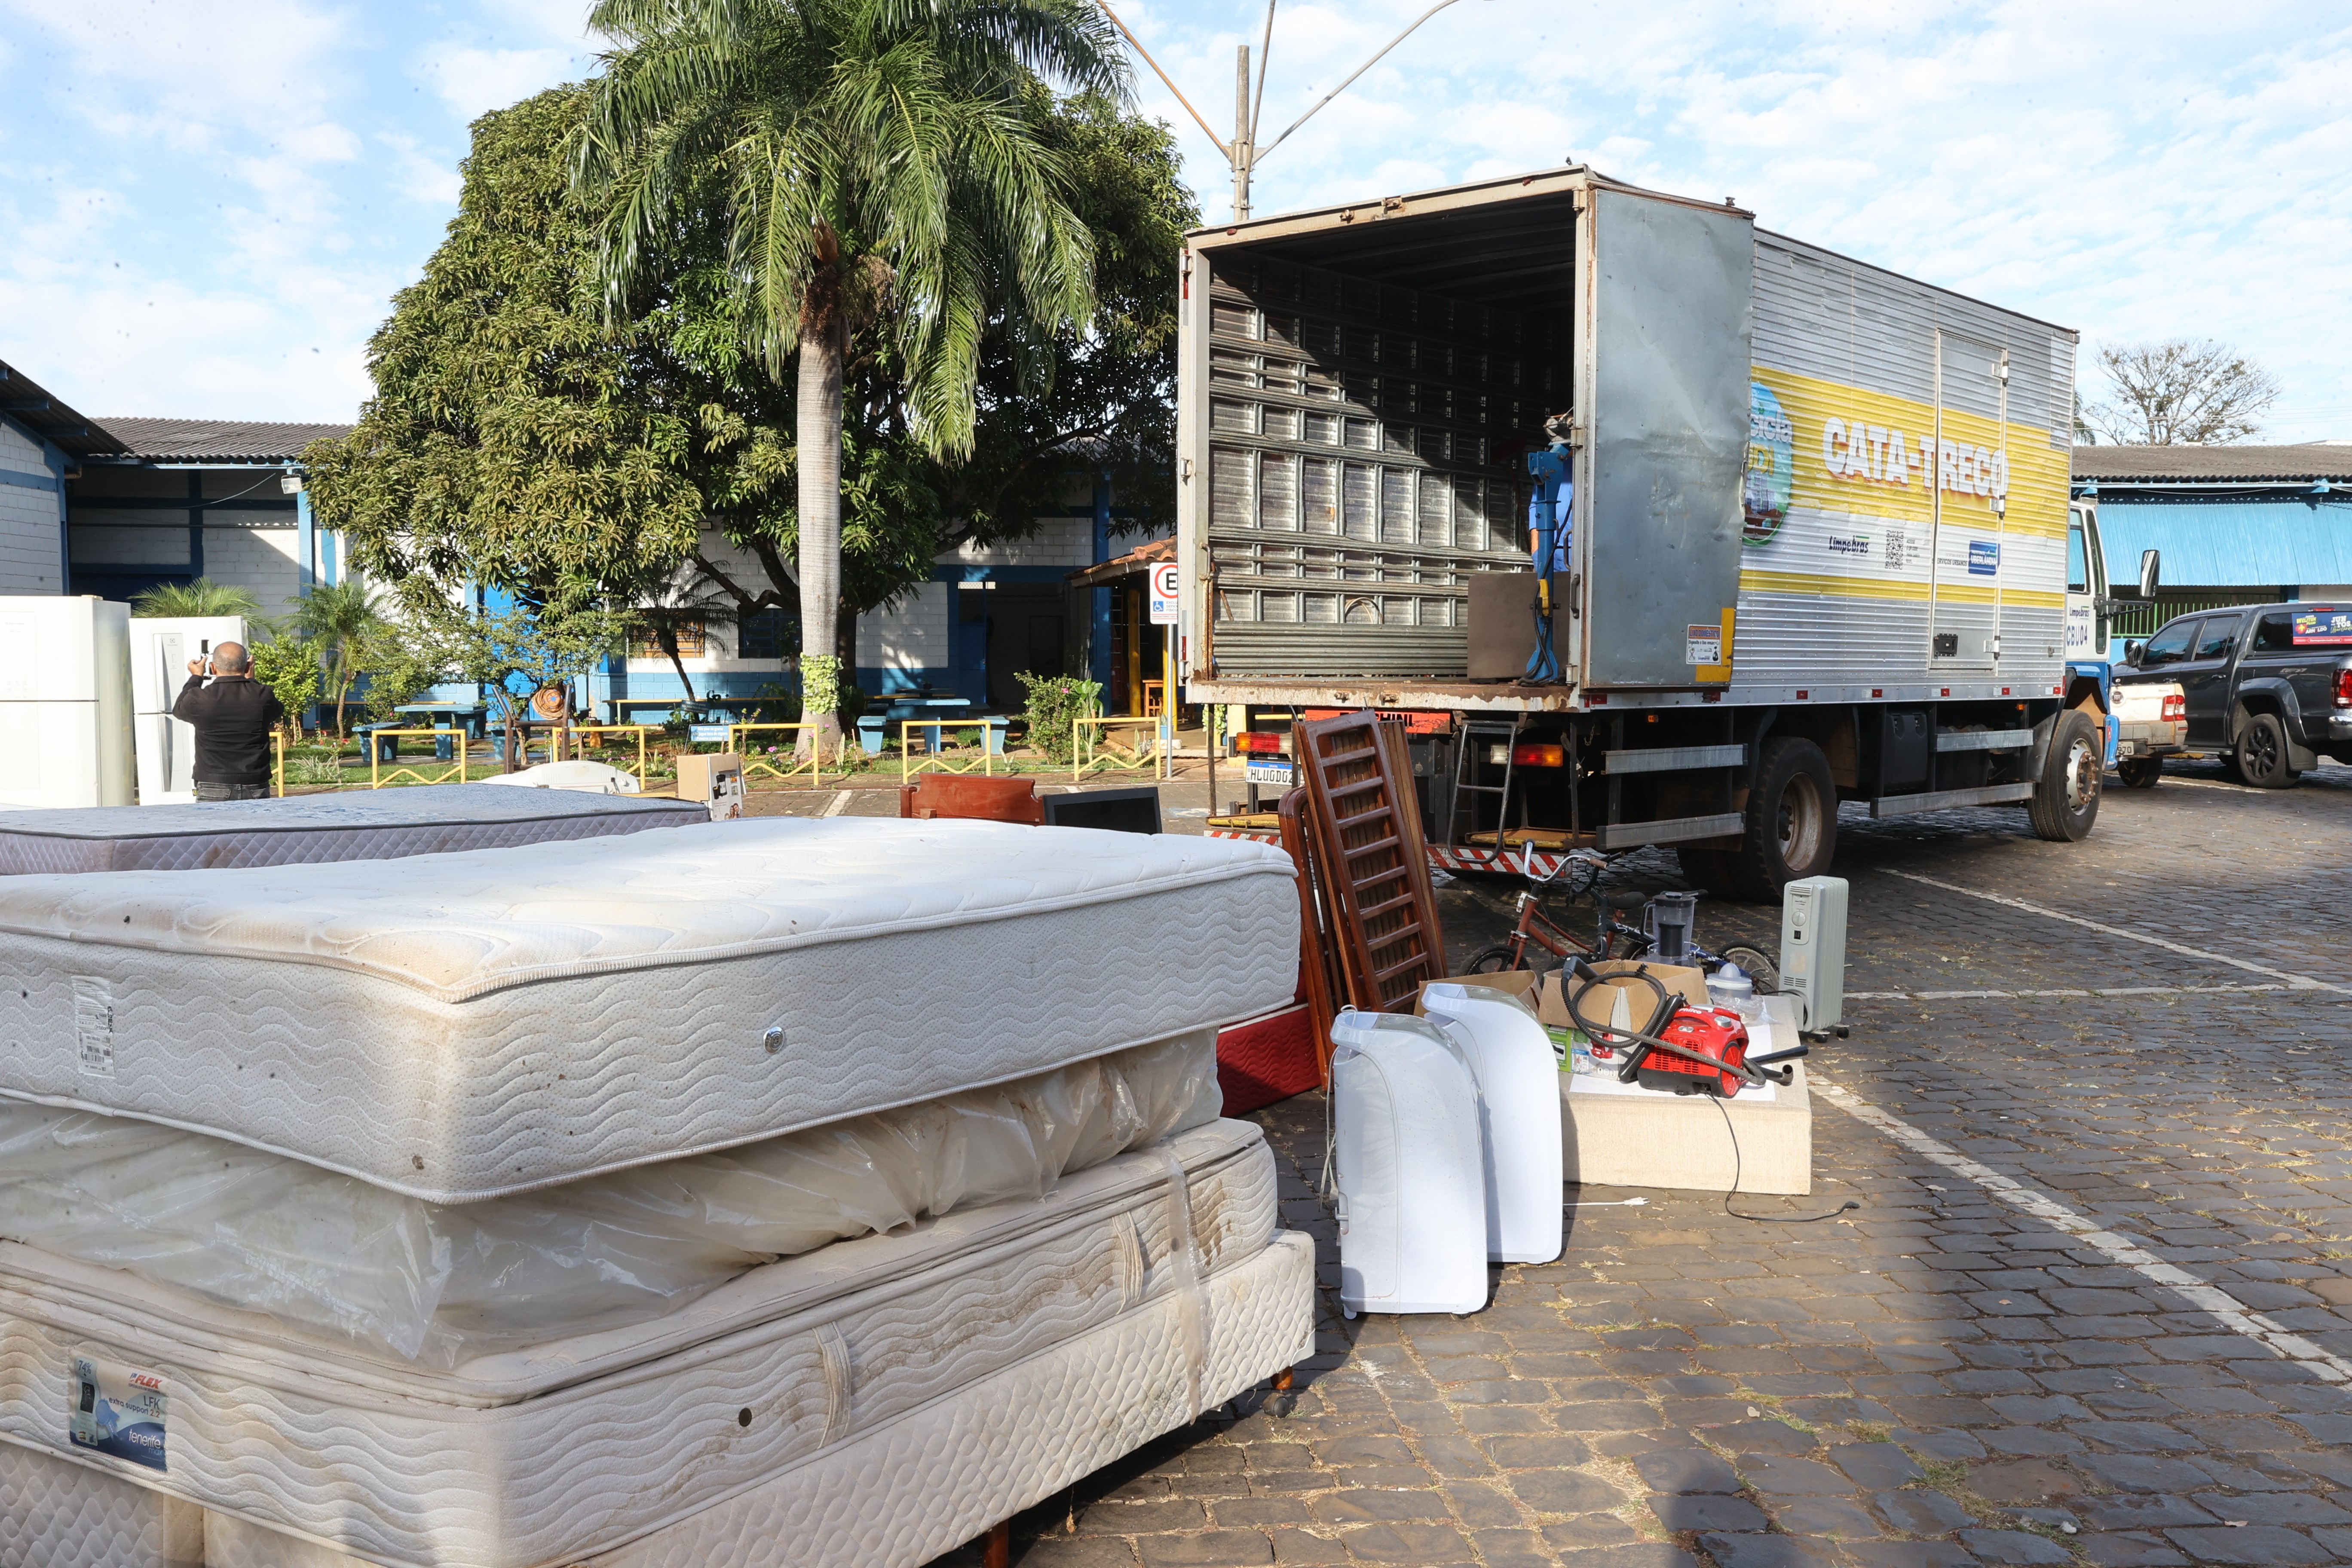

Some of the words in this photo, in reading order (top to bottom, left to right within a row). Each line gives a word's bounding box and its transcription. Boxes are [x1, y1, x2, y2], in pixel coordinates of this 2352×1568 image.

[1823, 417, 2009, 499] CATA-TRECO
[1828, 536, 1869, 554] Limpebras
[1166, 573, 1177, 590] E
[2070, 606, 2089, 619] Limpebras
[2066, 625, 2088, 646] CBU04
[79, 1360, 92, 1374] 74%
[135, 1374, 163, 1389] FLEX
[109, 1397, 124, 1407] extra
[126, 1403, 149, 1415] support
[150, 1409, 160, 1419] 2.2
[143, 1395, 160, 1410] LFK
[129, 1428, 161, 1449] tenerife
[148, 1448, 163, 1456] max
